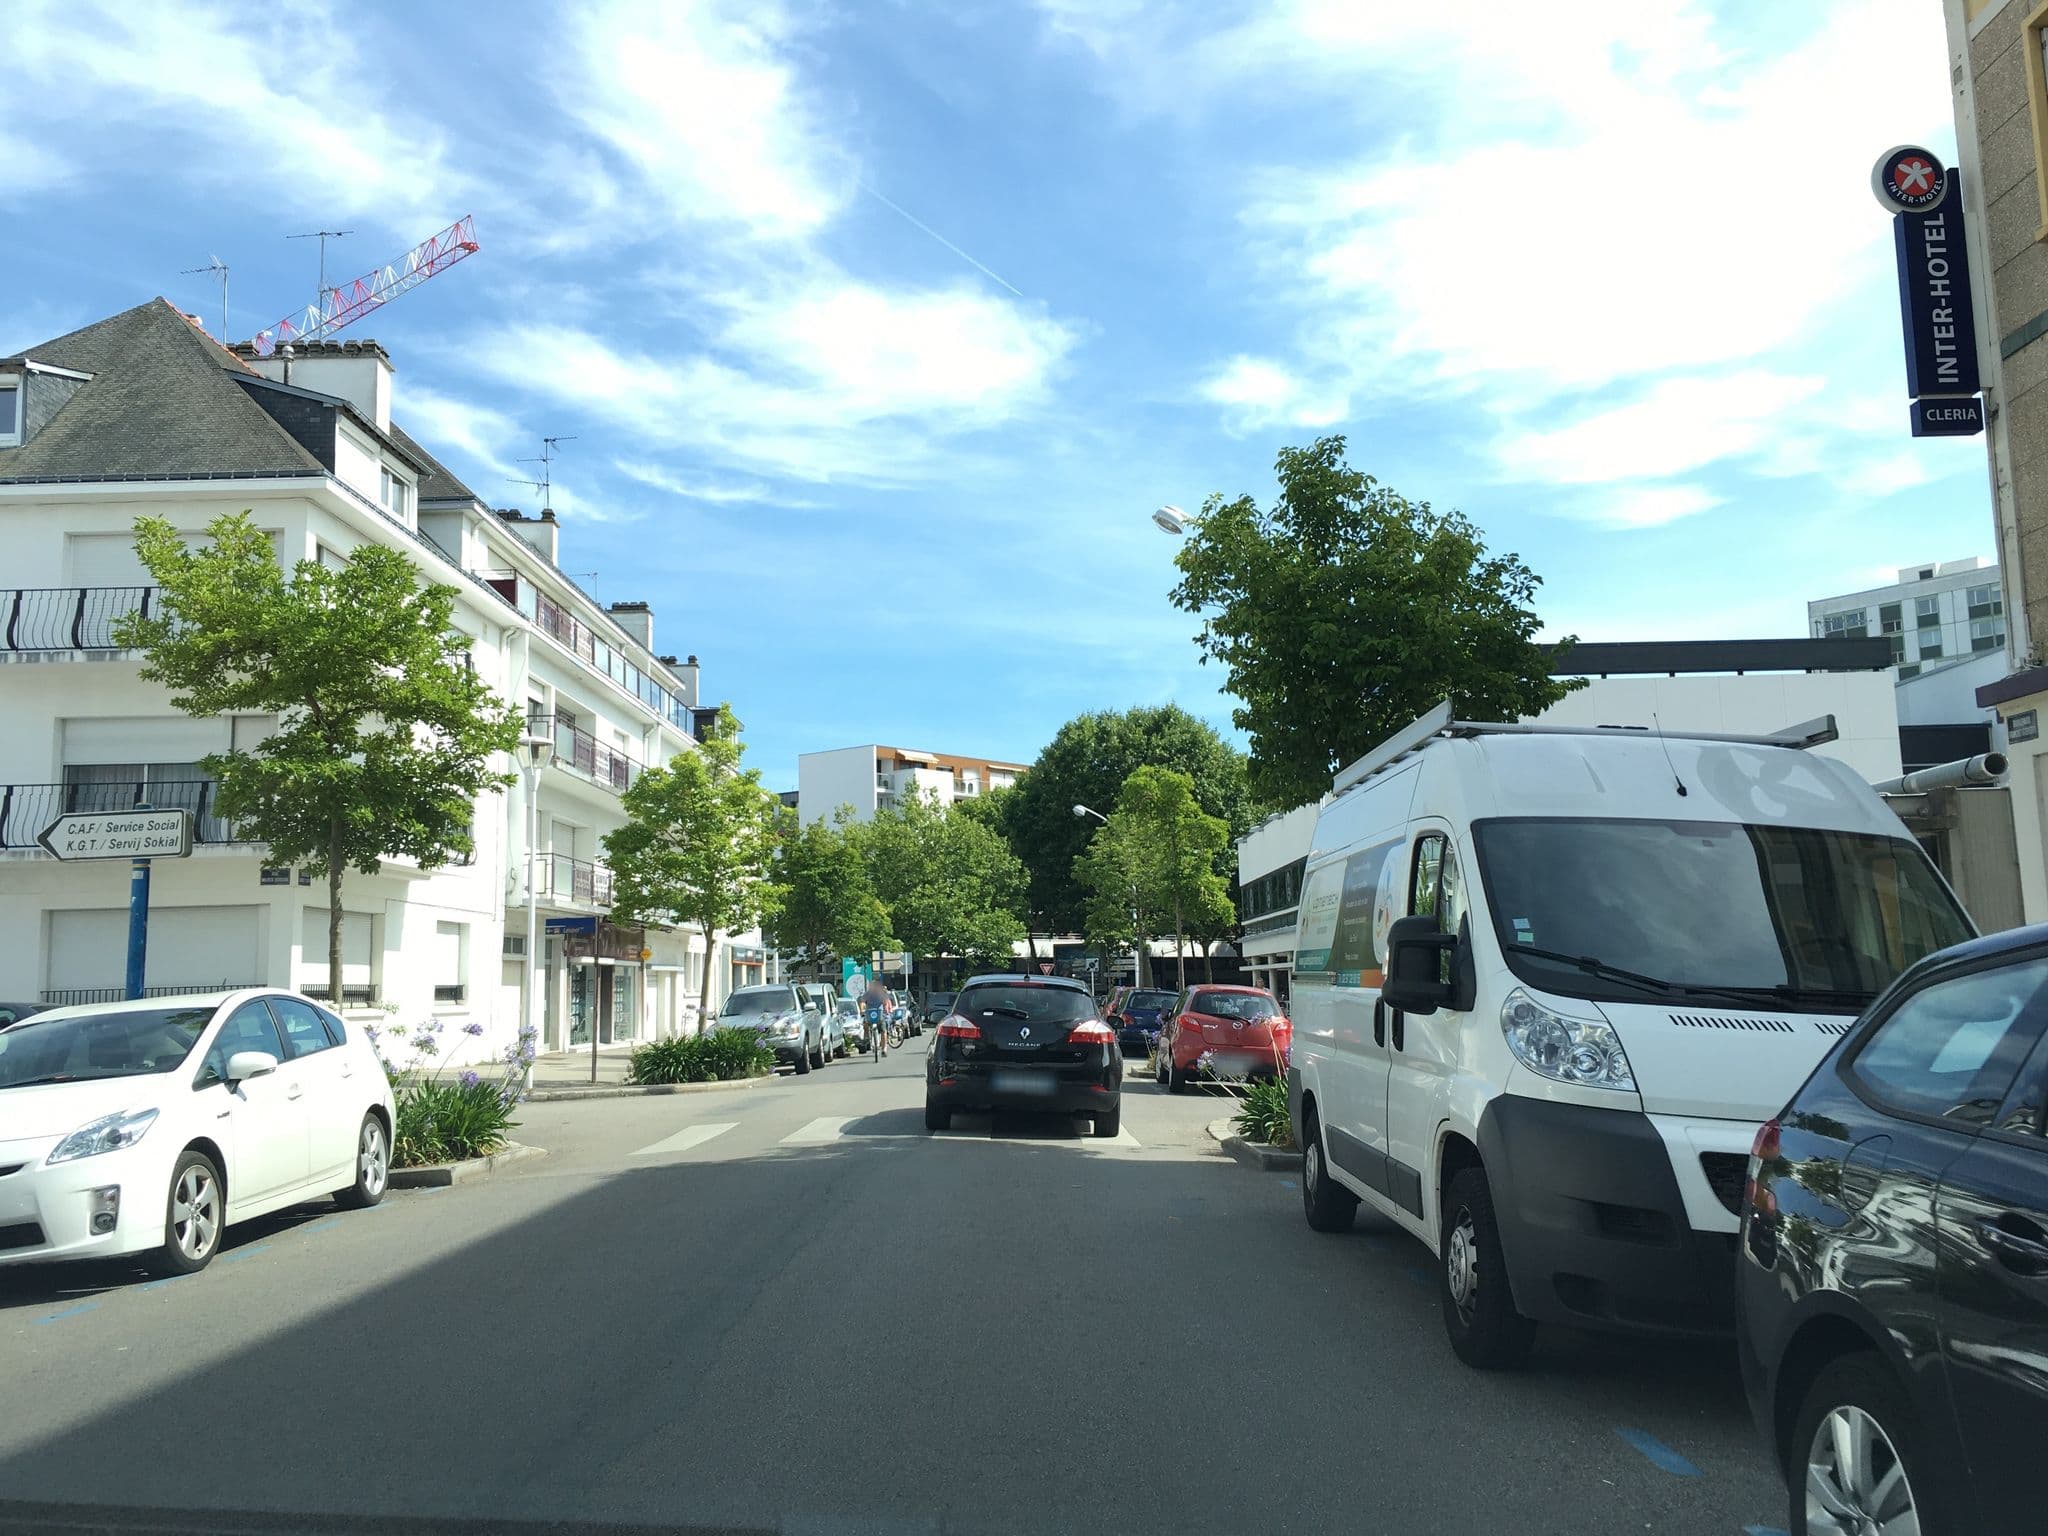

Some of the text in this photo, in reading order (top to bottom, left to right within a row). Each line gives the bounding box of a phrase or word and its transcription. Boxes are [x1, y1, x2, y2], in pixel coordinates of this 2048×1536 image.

[1888, 179, 1942, 204] INTER-HOTEL
[1924, 212, 1959, 383] INTER-HOTEL
[1926, 408, 1977, 421] CLERIA
[105, 820, 144, 833] Service
[147, 819, 180, 831] Social
[108, 838, 141, 851] Servij
[144, 836, 179, 848] Sokial
